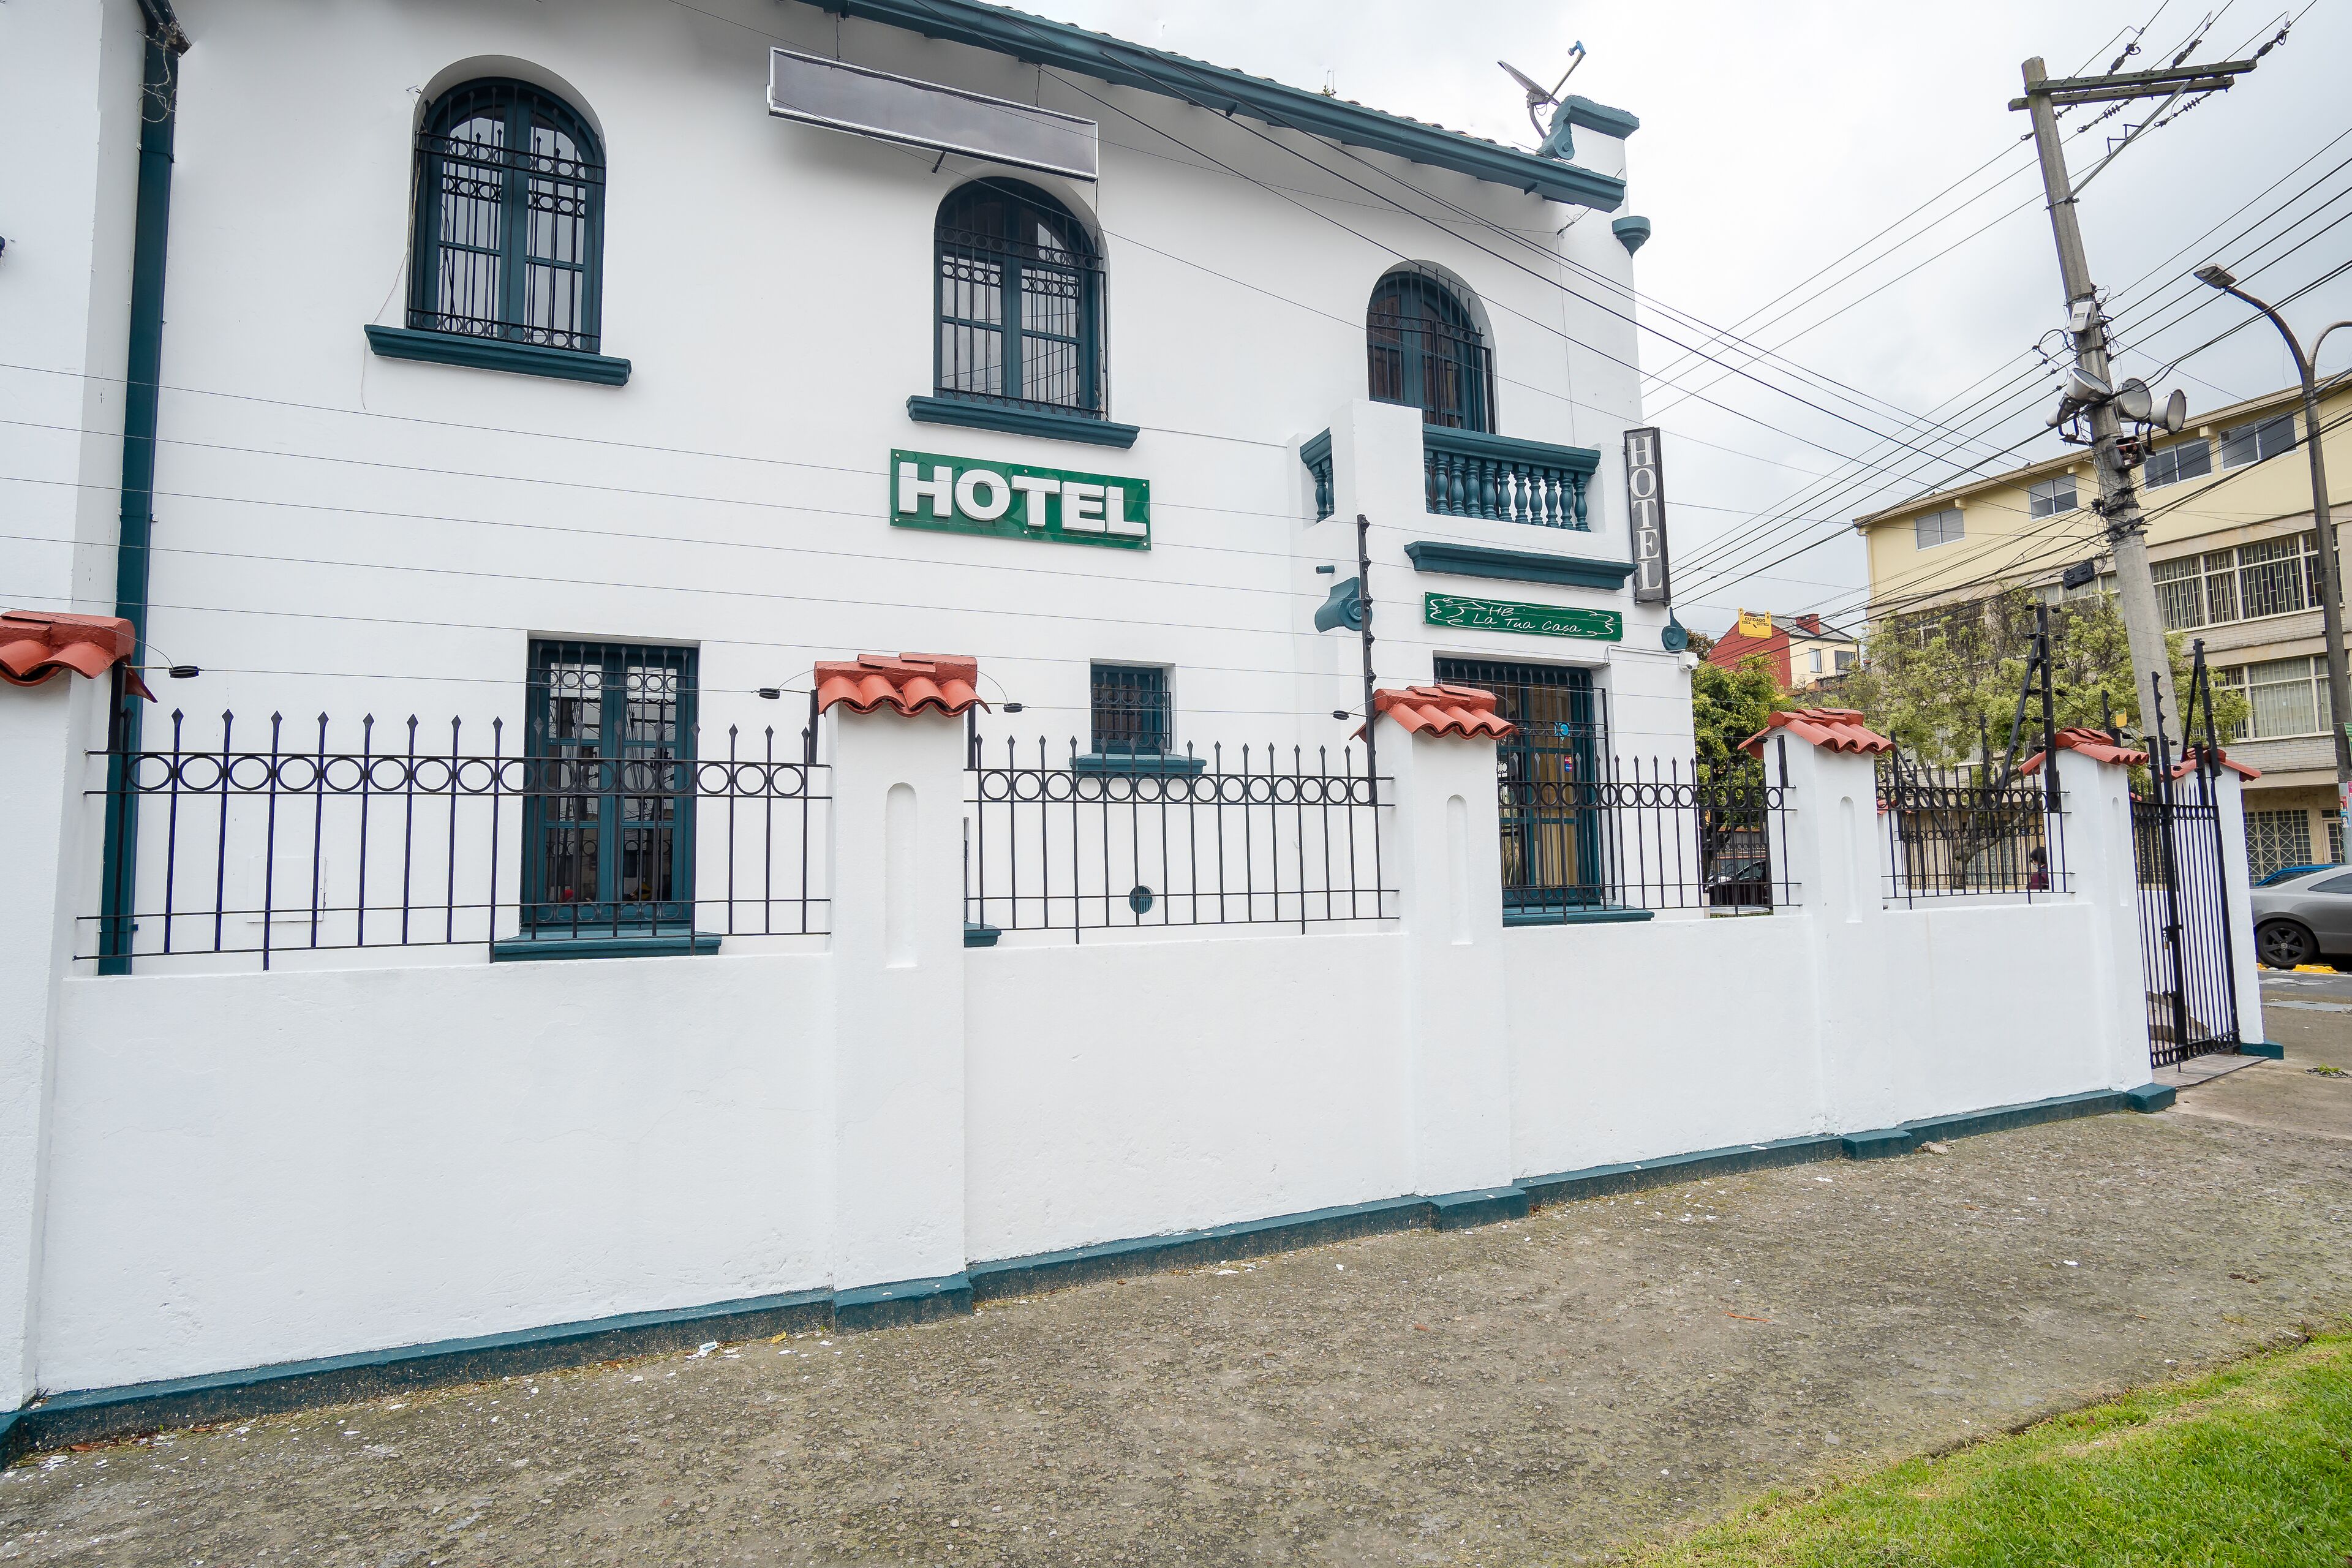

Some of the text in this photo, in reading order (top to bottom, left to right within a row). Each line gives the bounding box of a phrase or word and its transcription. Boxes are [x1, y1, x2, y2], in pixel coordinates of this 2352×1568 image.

[899, 462, 1147, 537] HOTEL
[1626, 435, 1663, 590] HOTEL
[1472, 613, 1582, 633] La Tua Casa
